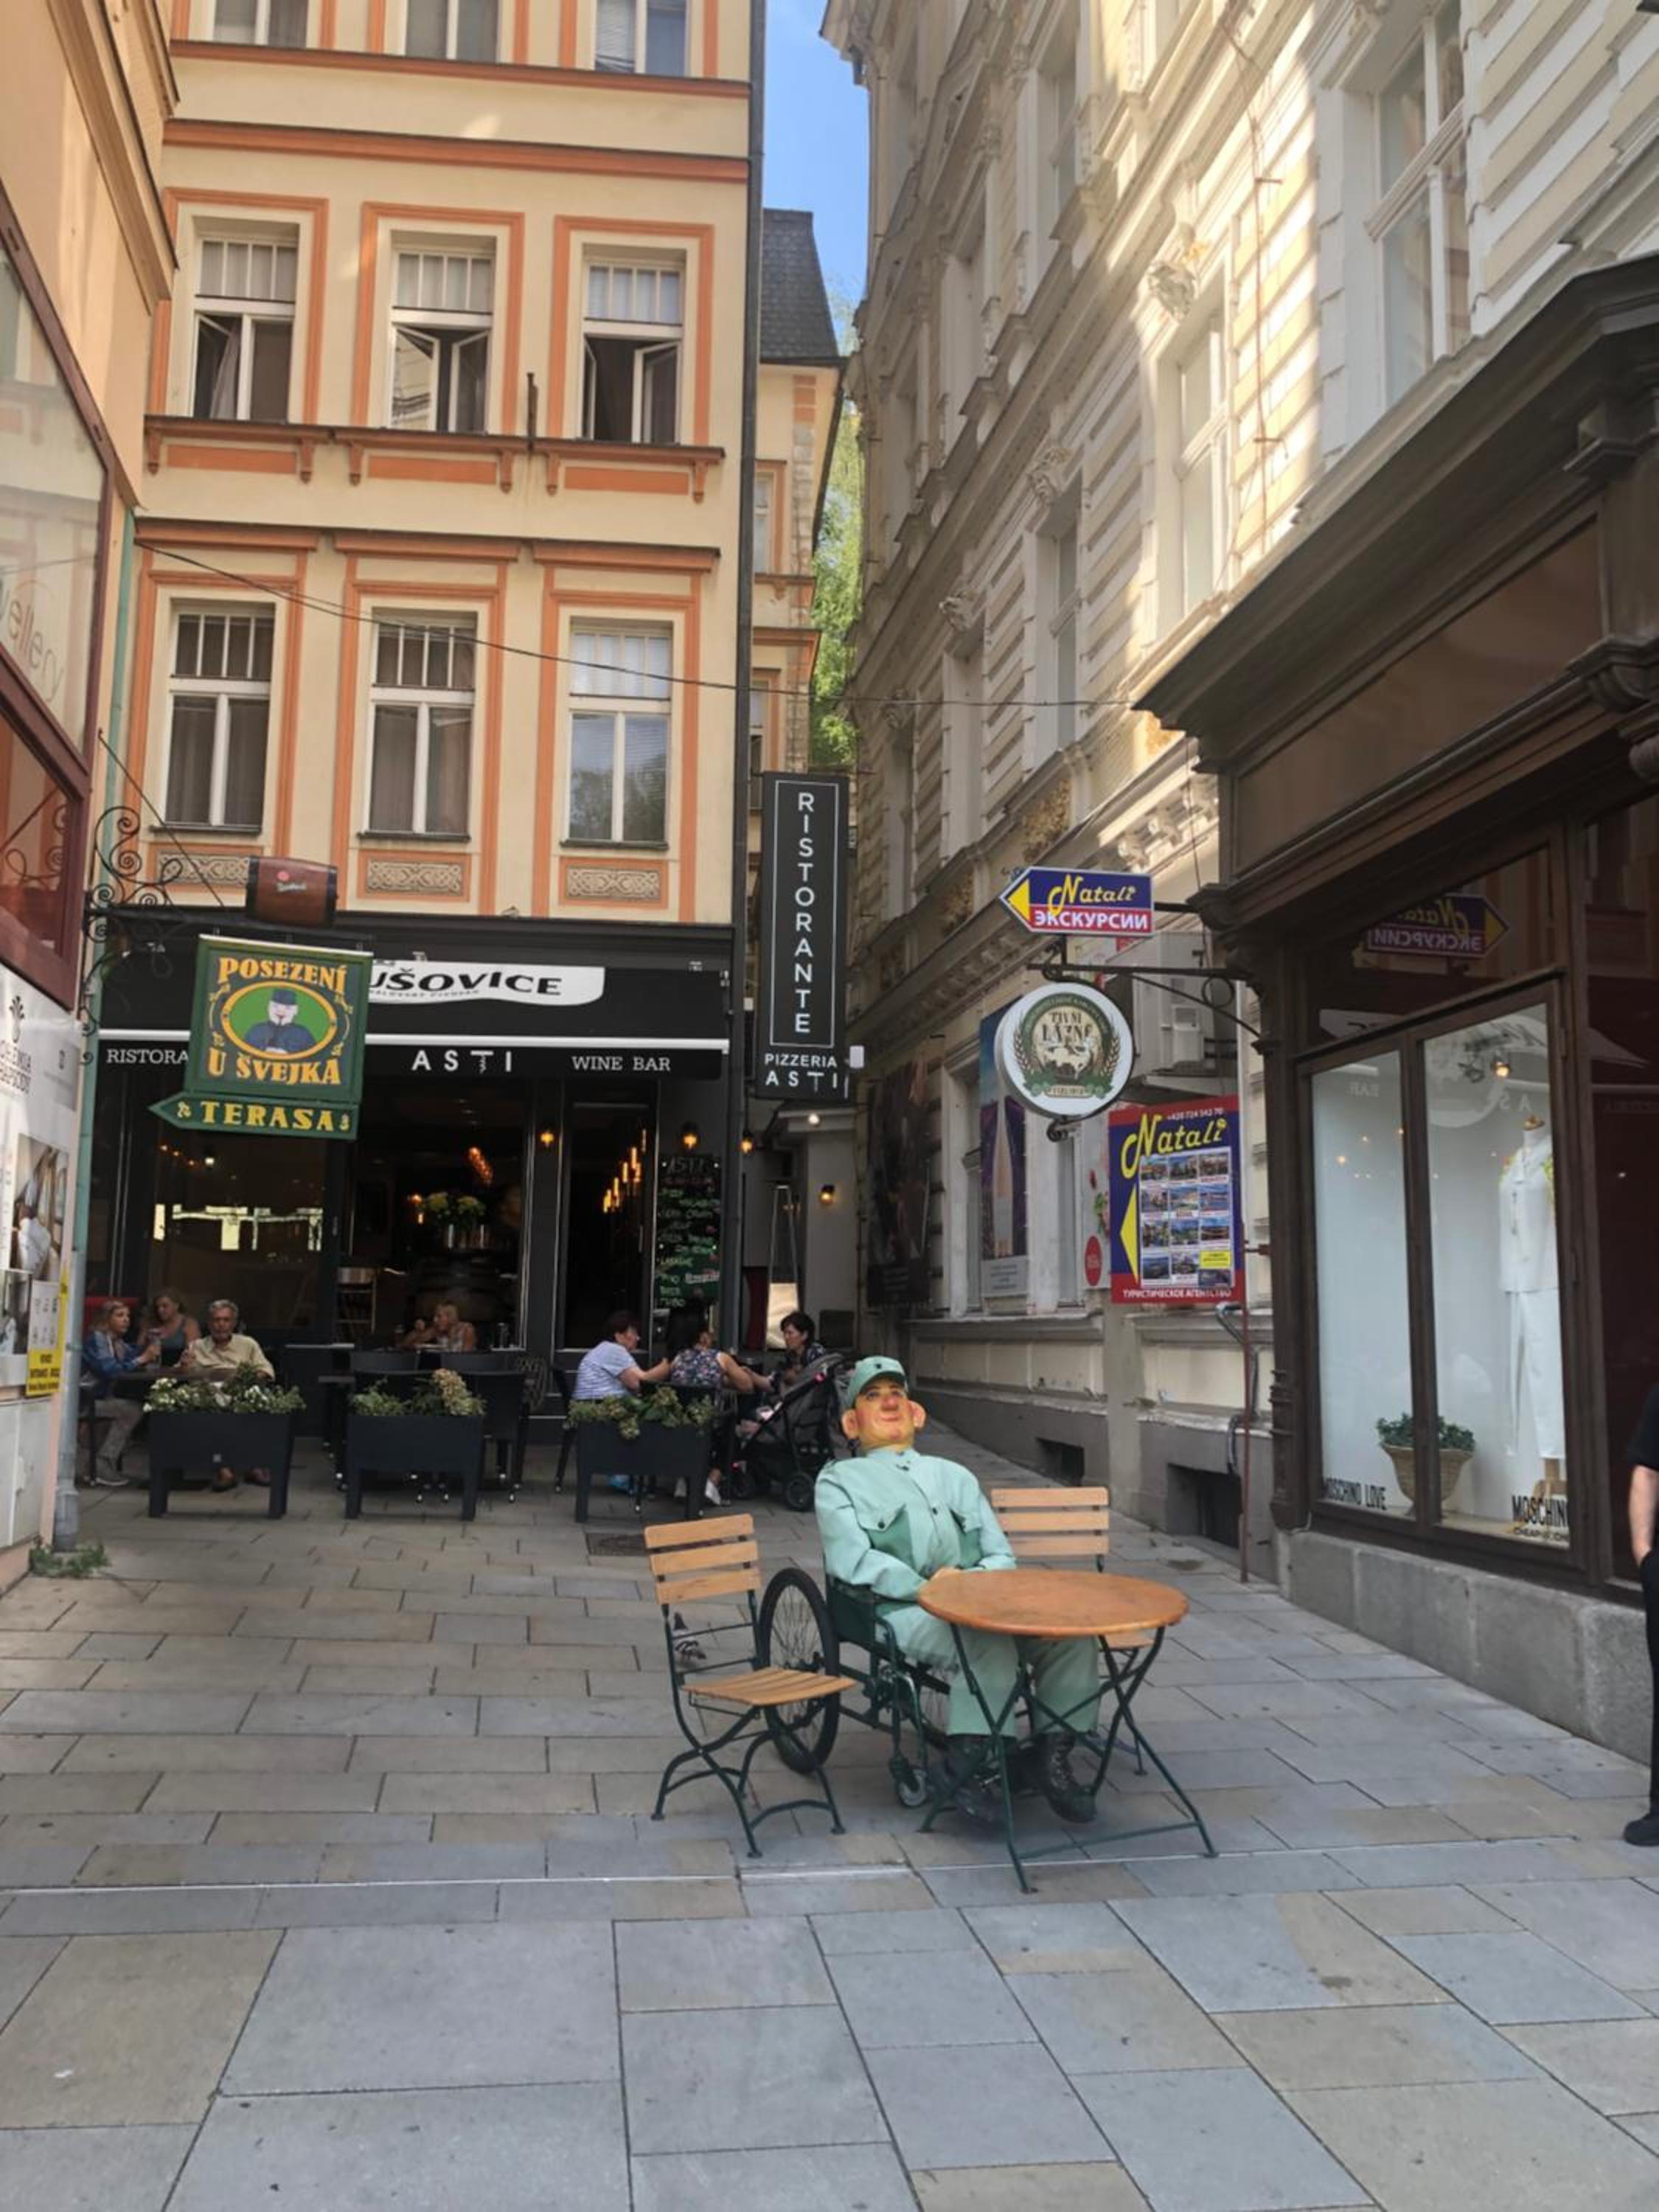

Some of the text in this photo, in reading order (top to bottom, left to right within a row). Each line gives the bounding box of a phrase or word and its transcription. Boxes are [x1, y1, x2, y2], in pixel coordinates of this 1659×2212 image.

[1048, 874, 1136, 917] Natali
[794, 792, 815, 1033] RISTORANTE
[1034, 911, 1147, 929] ЭКСКУРСИИ
[218, 956, 348, 995] POSEZENÍ
[207, 1046, 341, 1085] U ŠVEJKA
[411, 1050, 512, 1074] ASTI
[571, 1056, 672, 1071] WINE BAR
[764, 1053, 838, 1068] PIZZERIA
[765, 1070, 838, 1092] ASTI
[200, 1101, 334, 1131] TERASA
[1121, 1113, 1227, 1179] Natali
[1512, 1495, 1568, 1527] MOSCHIN
